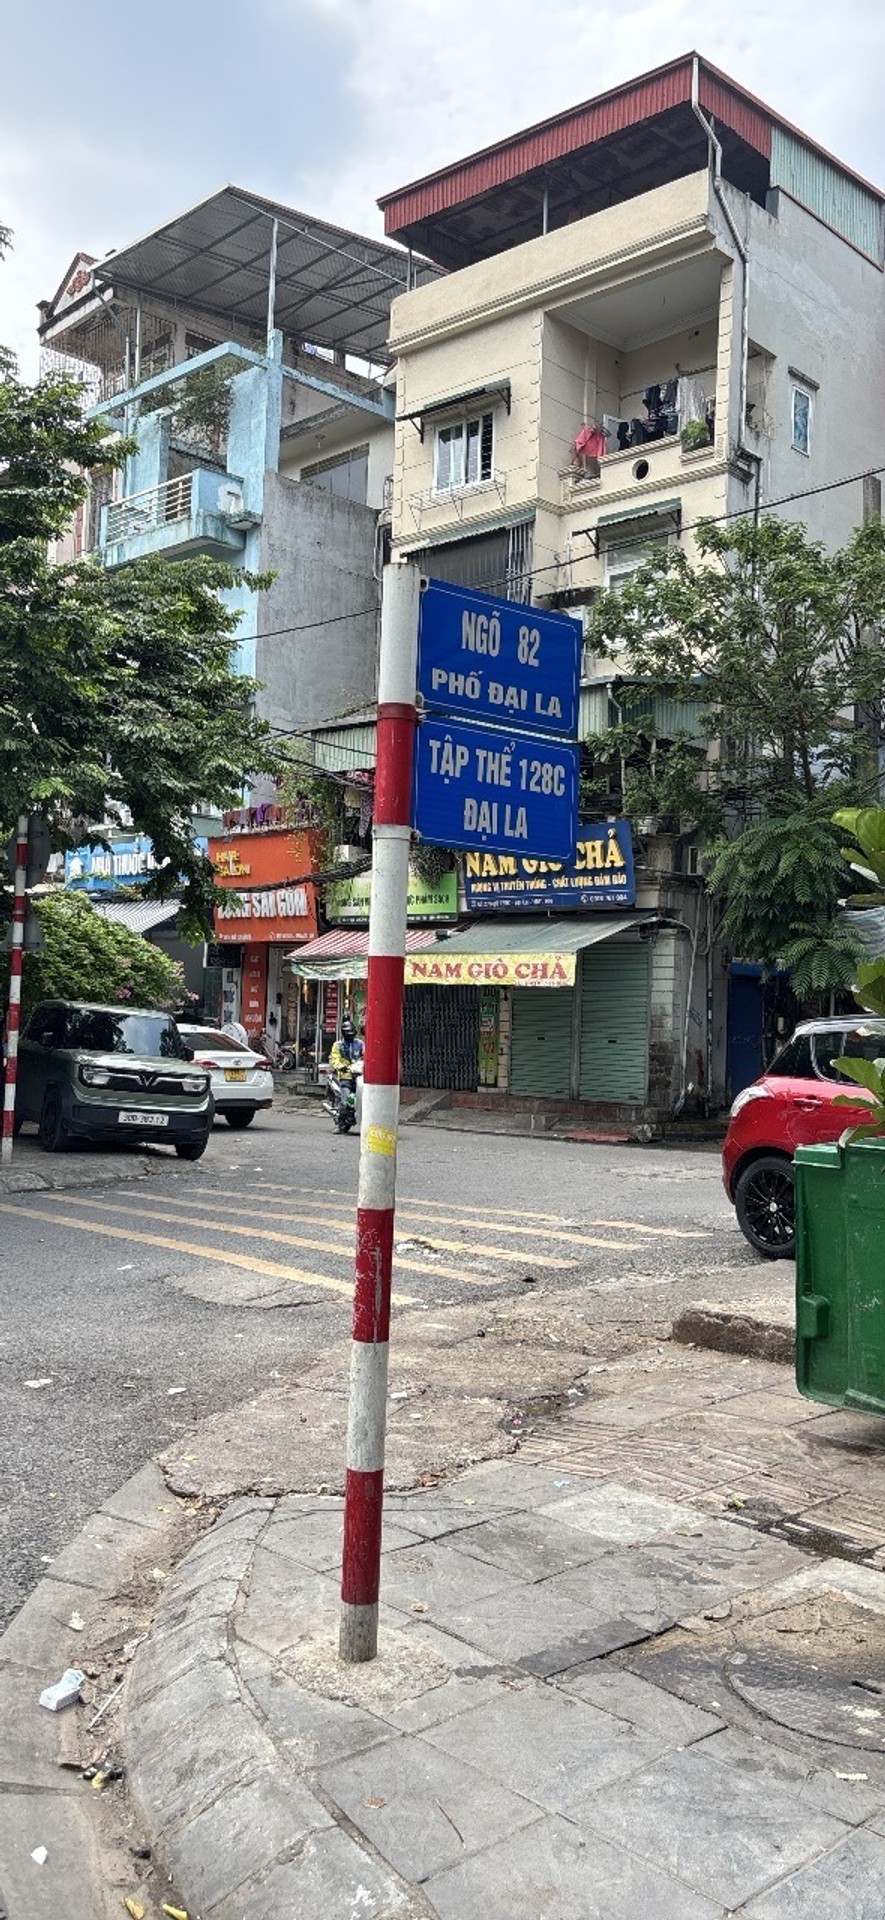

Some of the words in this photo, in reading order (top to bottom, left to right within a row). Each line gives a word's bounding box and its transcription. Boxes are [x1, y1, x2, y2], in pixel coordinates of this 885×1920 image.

[462, 610, 501, 657] NGÕ
[517, 625, 541, 667] 82
[432, 668, 483, 699] PHỐ
[488, 681, 528, 714] ĐẠI
[535, 692, 562, 718] LA
[429, 734, 469, 784] TẬP
[476, 741, 516, 787] THỂ
[519, 759, 566, 796] 128C
[463, 798, 498, 841] ĐẠI
[504, 804, 528, 840] LA
[466, 851, 518, 877] NAM
[574, 828, 626, 869] CHẢ
[411, 961, 463, 979] NAM
[514, 955, 567, 980] CHẢ
